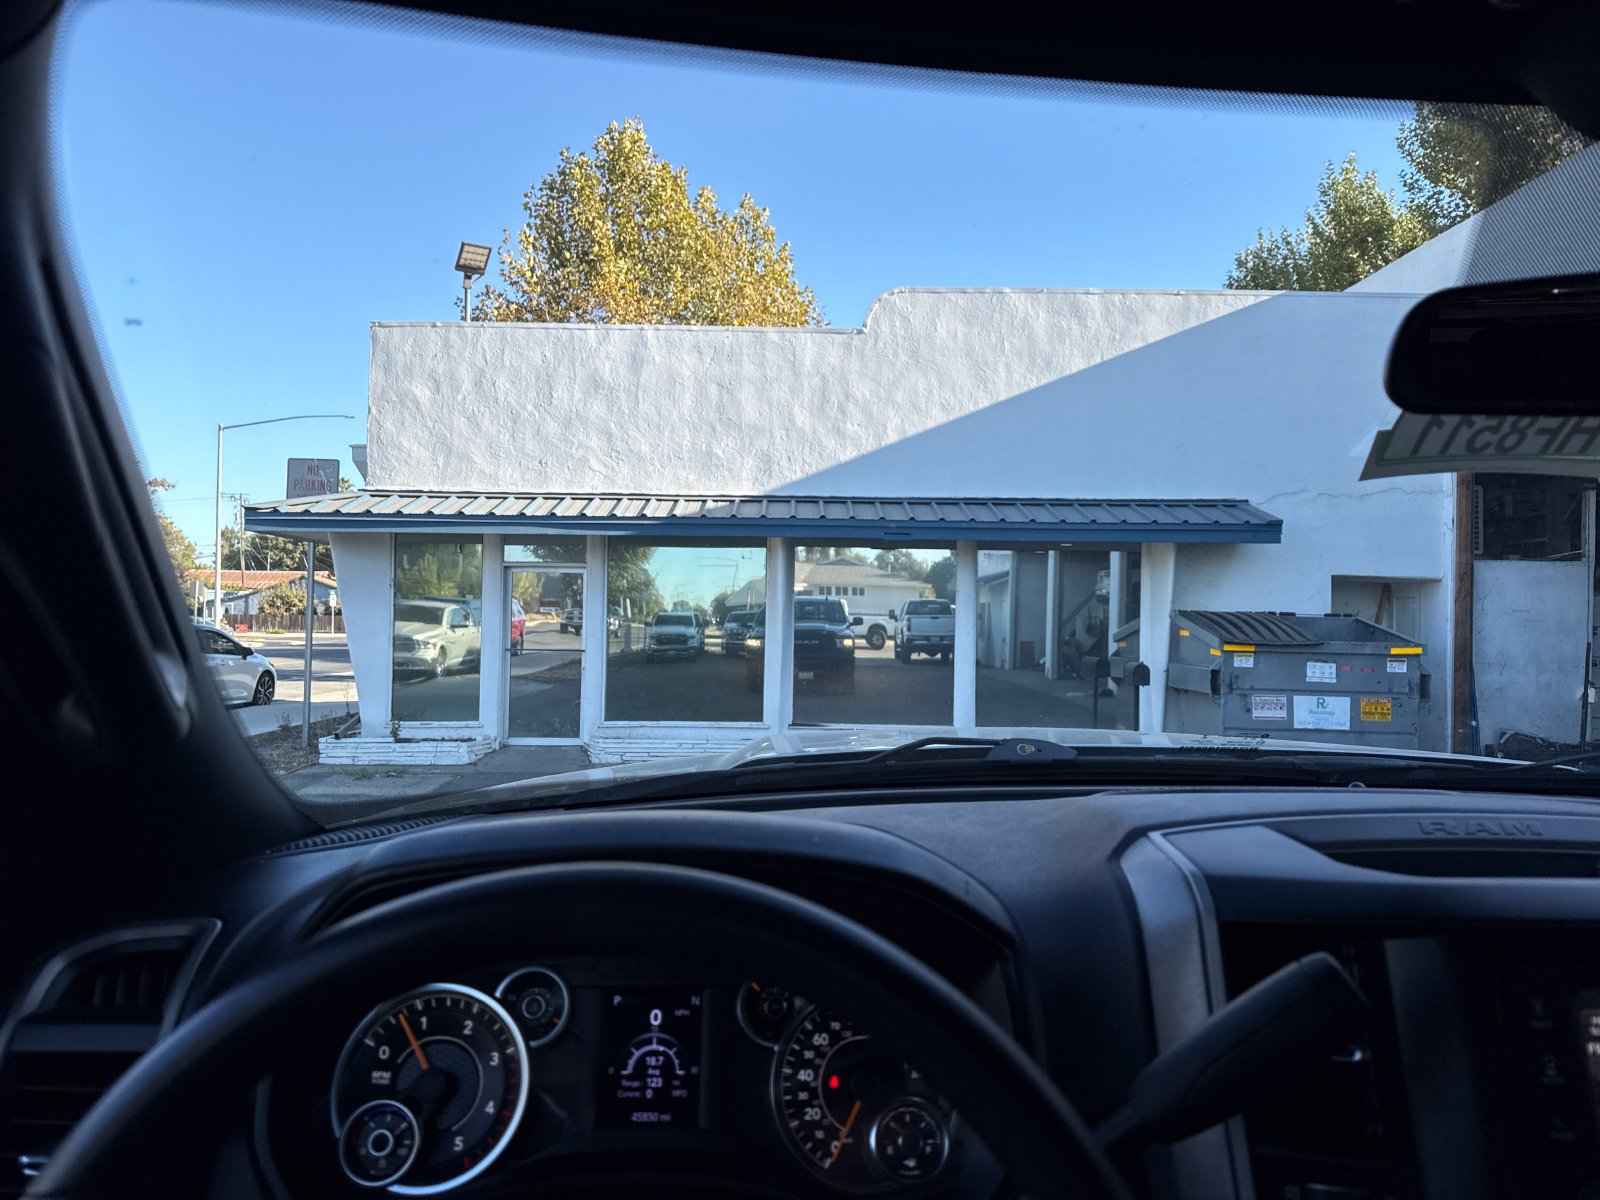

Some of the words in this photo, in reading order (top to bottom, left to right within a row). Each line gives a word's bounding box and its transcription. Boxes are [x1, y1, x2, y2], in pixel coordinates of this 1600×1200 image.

[293, 479, 332, 492] PARKING
[1417, 819, 1542, 836] RAM
[612, 994, 622, 1006] P
[690, 995, 700, 1006] N
[420, 1016, 428, 1030] 1
[649, 1008, 663, 1026] 0
[463, 1020, 473, 1035] 2
[812, 1033, 829, 1046] 60
[377, 1045, 390, 1060] 0
[489, 1052, 499, 1066] 3
[803, 1050, 815, 1060] 50
[797, 1069, 814, 1082] 40
[645, 1088, 654, 1099] 0
[484, 1101, 495, 1115] 4
[804, 1108, 821, 1121] 20
[453, 1136, 464, 1151] 5
